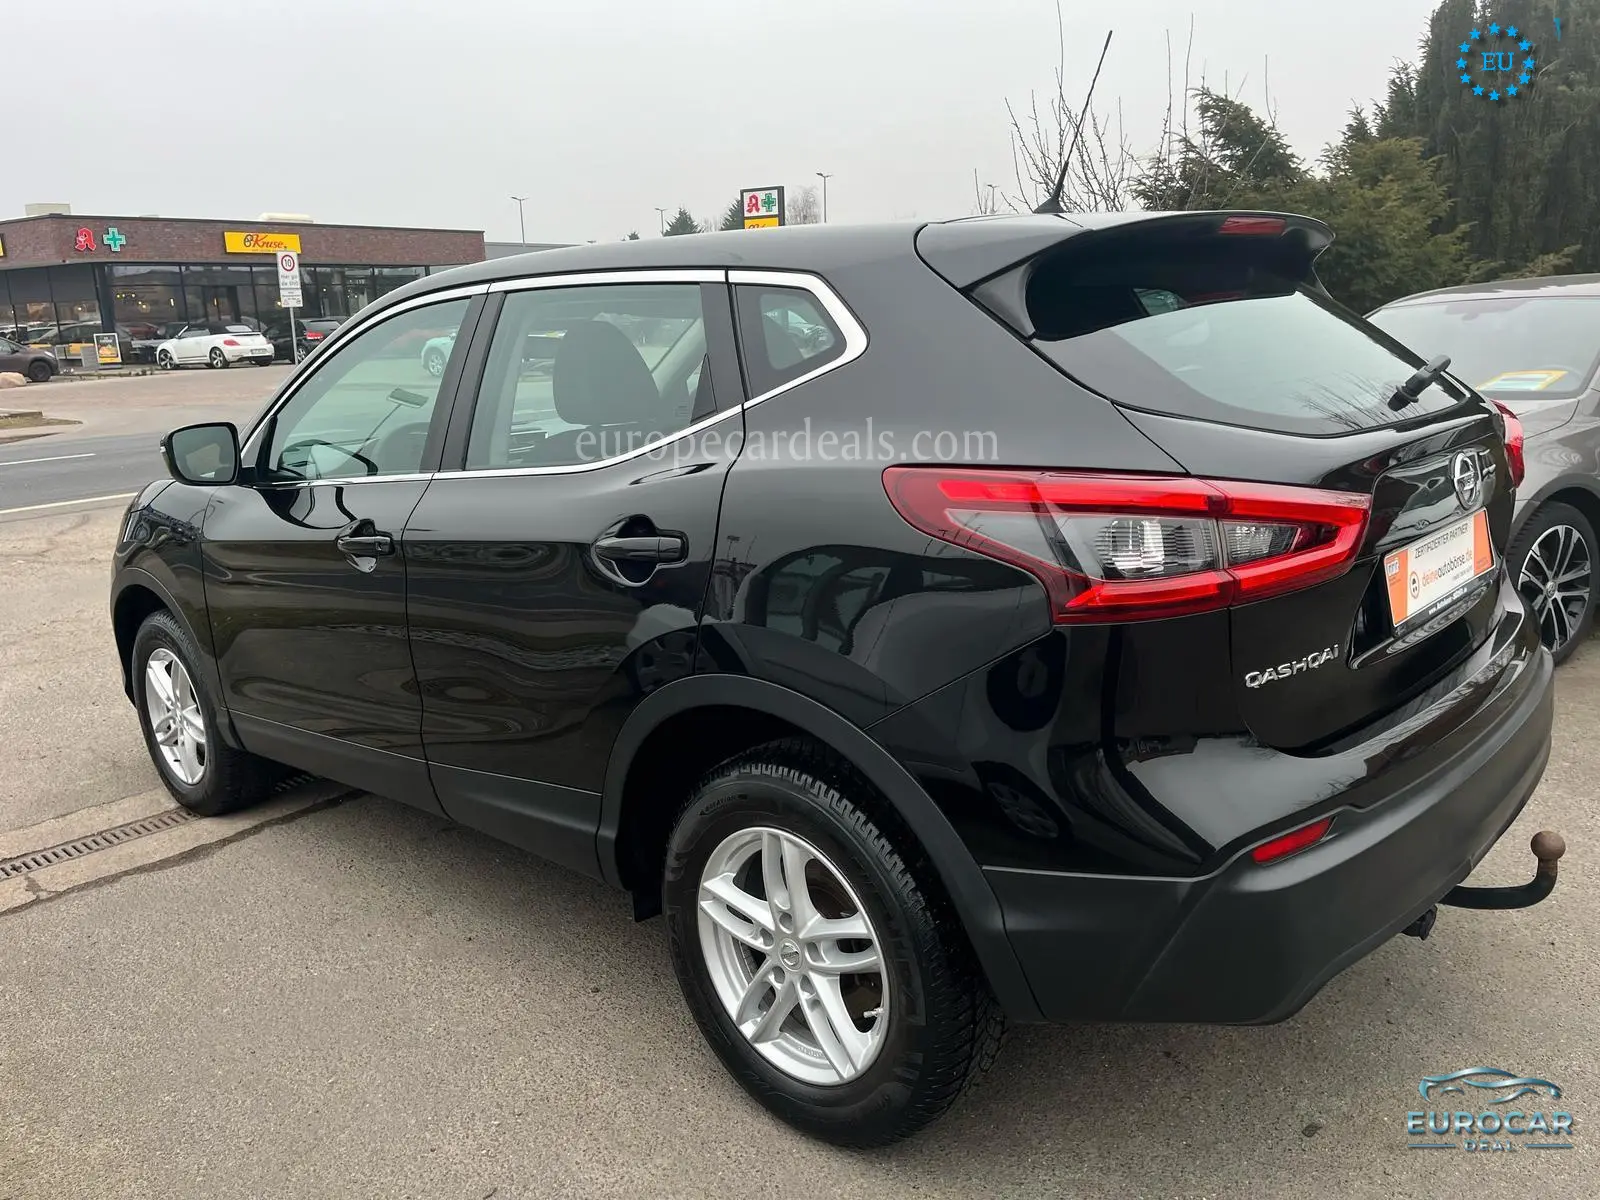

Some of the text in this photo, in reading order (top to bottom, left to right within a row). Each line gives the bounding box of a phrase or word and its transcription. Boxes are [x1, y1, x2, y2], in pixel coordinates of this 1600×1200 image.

[284, 258, 292, 267] 10
[1449, 522, 1469, 541] PARTNER
[1244, 643, 1340, 689] QASHQAI
